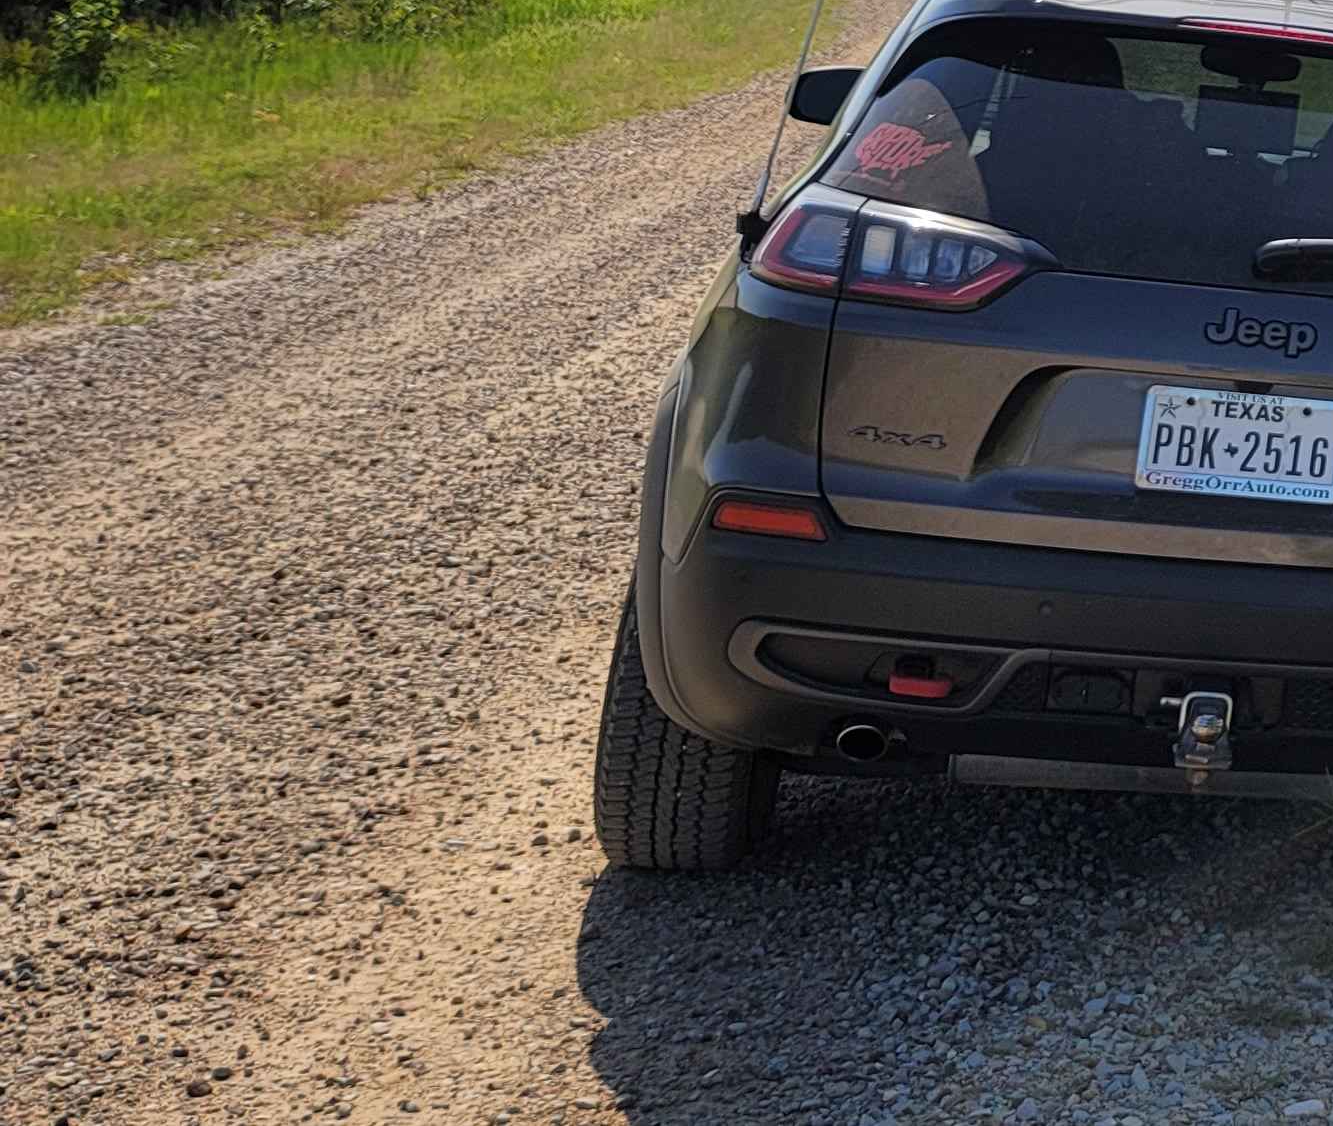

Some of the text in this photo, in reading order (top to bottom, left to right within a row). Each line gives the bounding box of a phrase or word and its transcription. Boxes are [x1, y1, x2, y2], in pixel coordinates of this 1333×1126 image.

[1204, 307, 1318, 358] Jeep
[1211, 400, 1285, 423] TEXAS
[1152, 423, 1329, 478] PBK 2516
[1145, 472, 1330, 499] GreggOrrAuto.com
